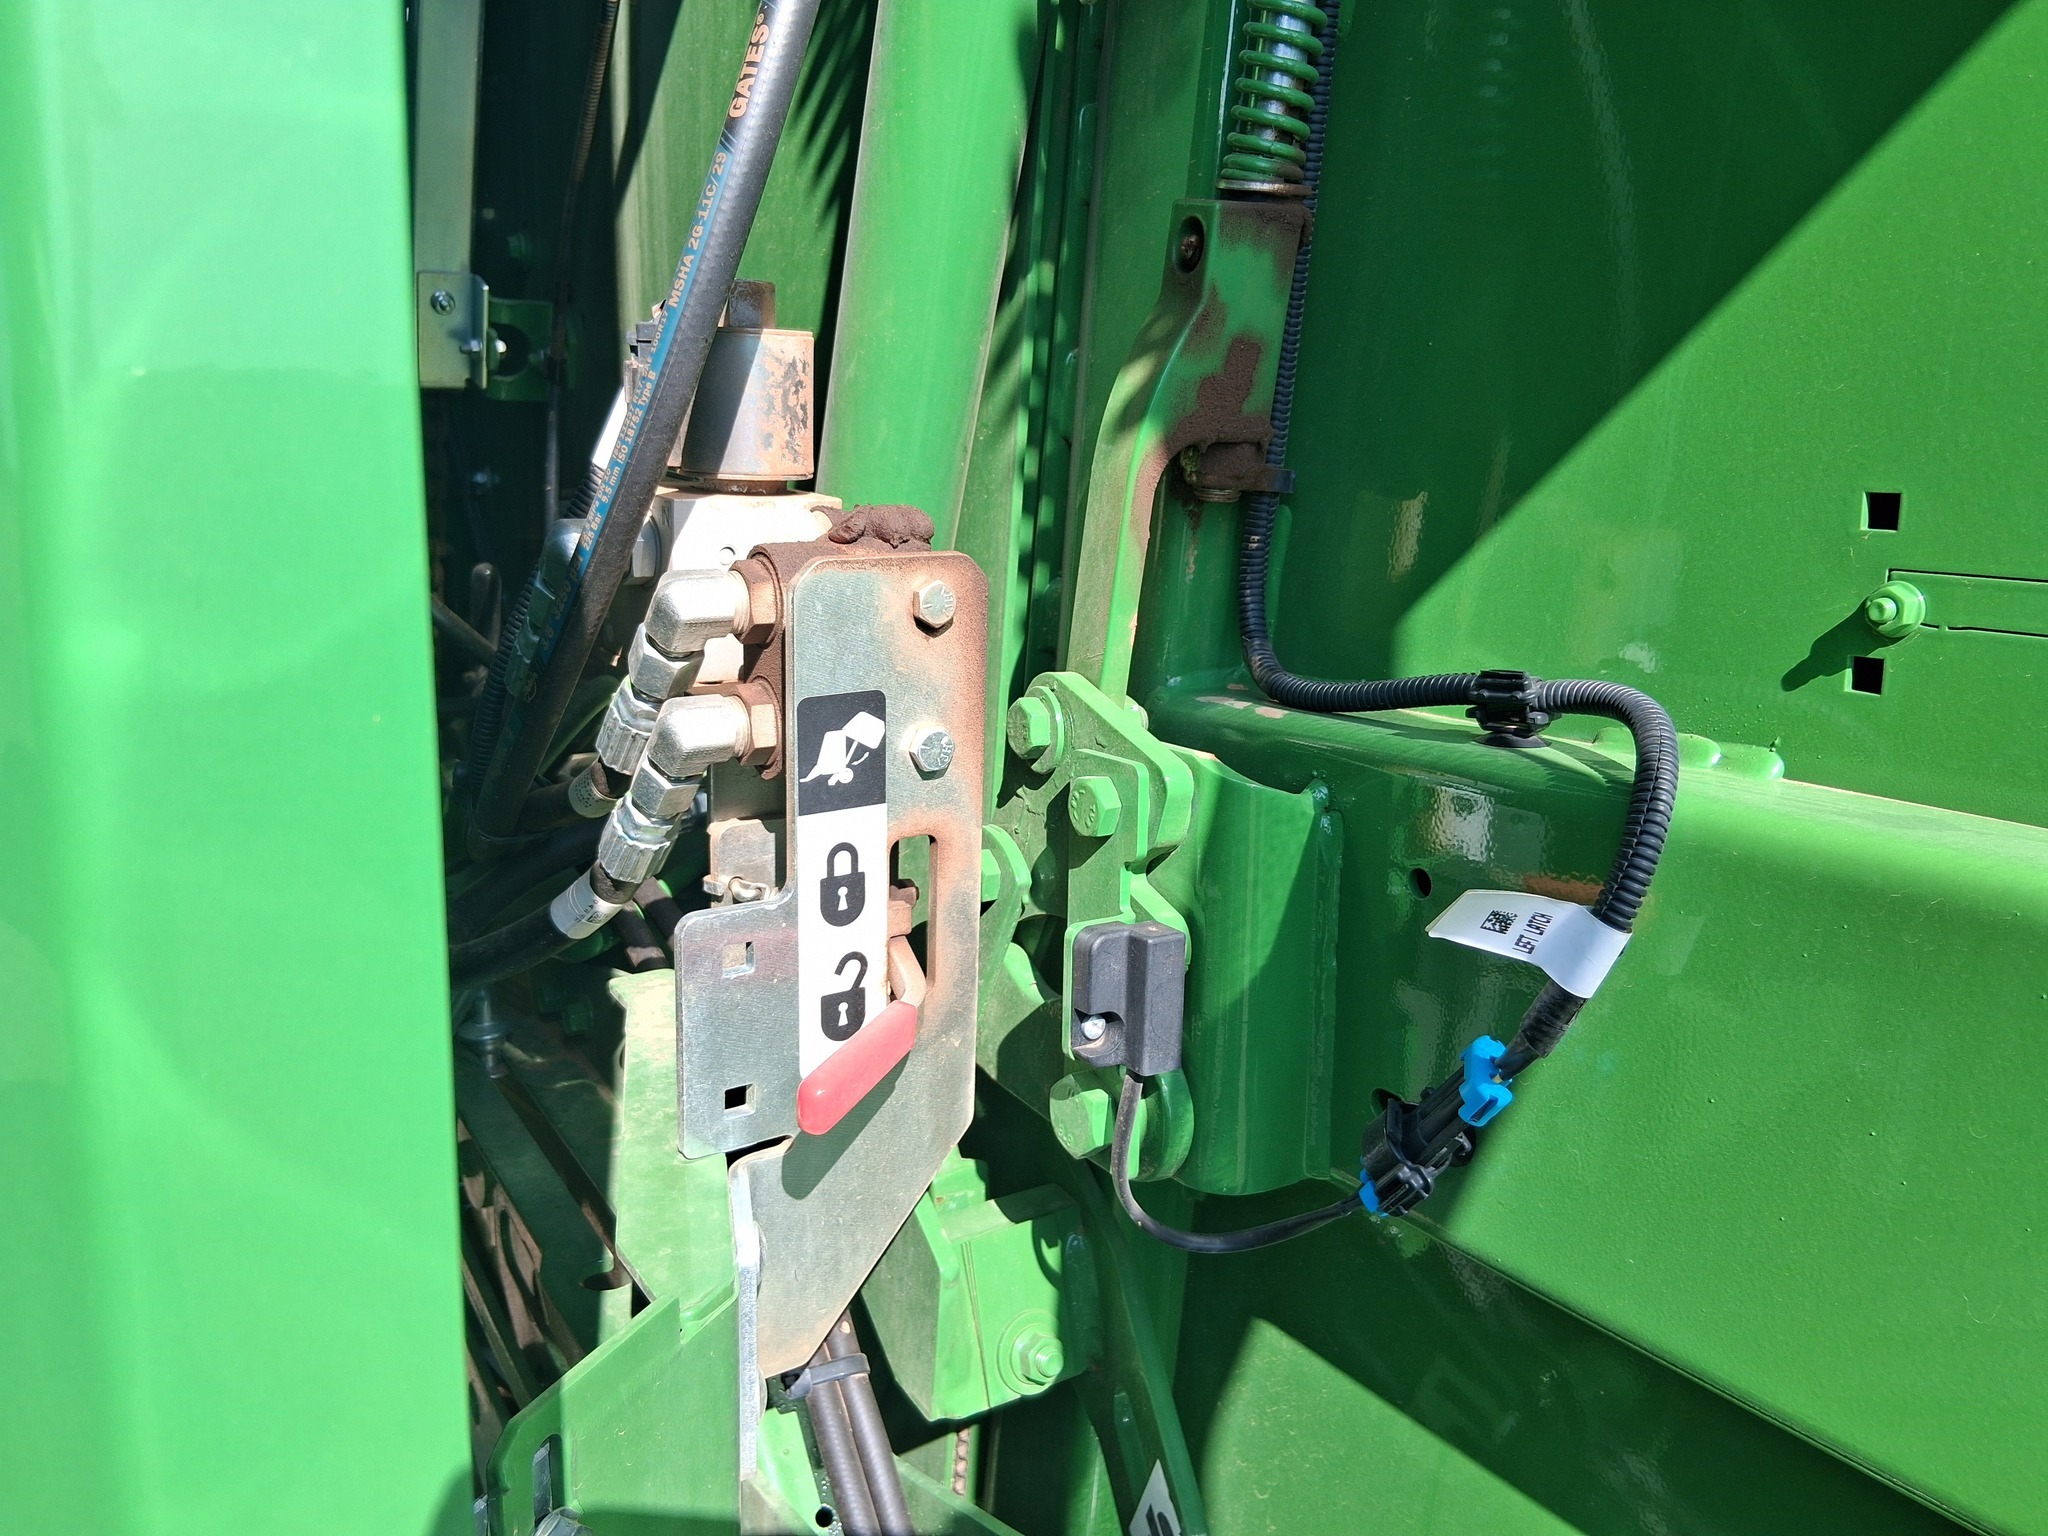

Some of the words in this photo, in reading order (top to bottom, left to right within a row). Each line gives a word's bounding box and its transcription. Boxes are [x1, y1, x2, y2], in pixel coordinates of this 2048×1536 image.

[668, 254, 695, 308] MSHA
[650, 309, 668, 353] 100R17
[583, 530, 595, 551] 225
[590, 512, 602, 531] Bar
[600, 485, 612, 504] 9.5
[608, 466, 620, 486] mm
[616, 444, 628, 463] ISO
[624, 408, 642, 444] 18752
[637, 381, 651, 404] Type
[647, 370, 656, 380] B
[1512, 934, 1539, 955] LEFT
[1523, 911, 1554, 936] LATCH
